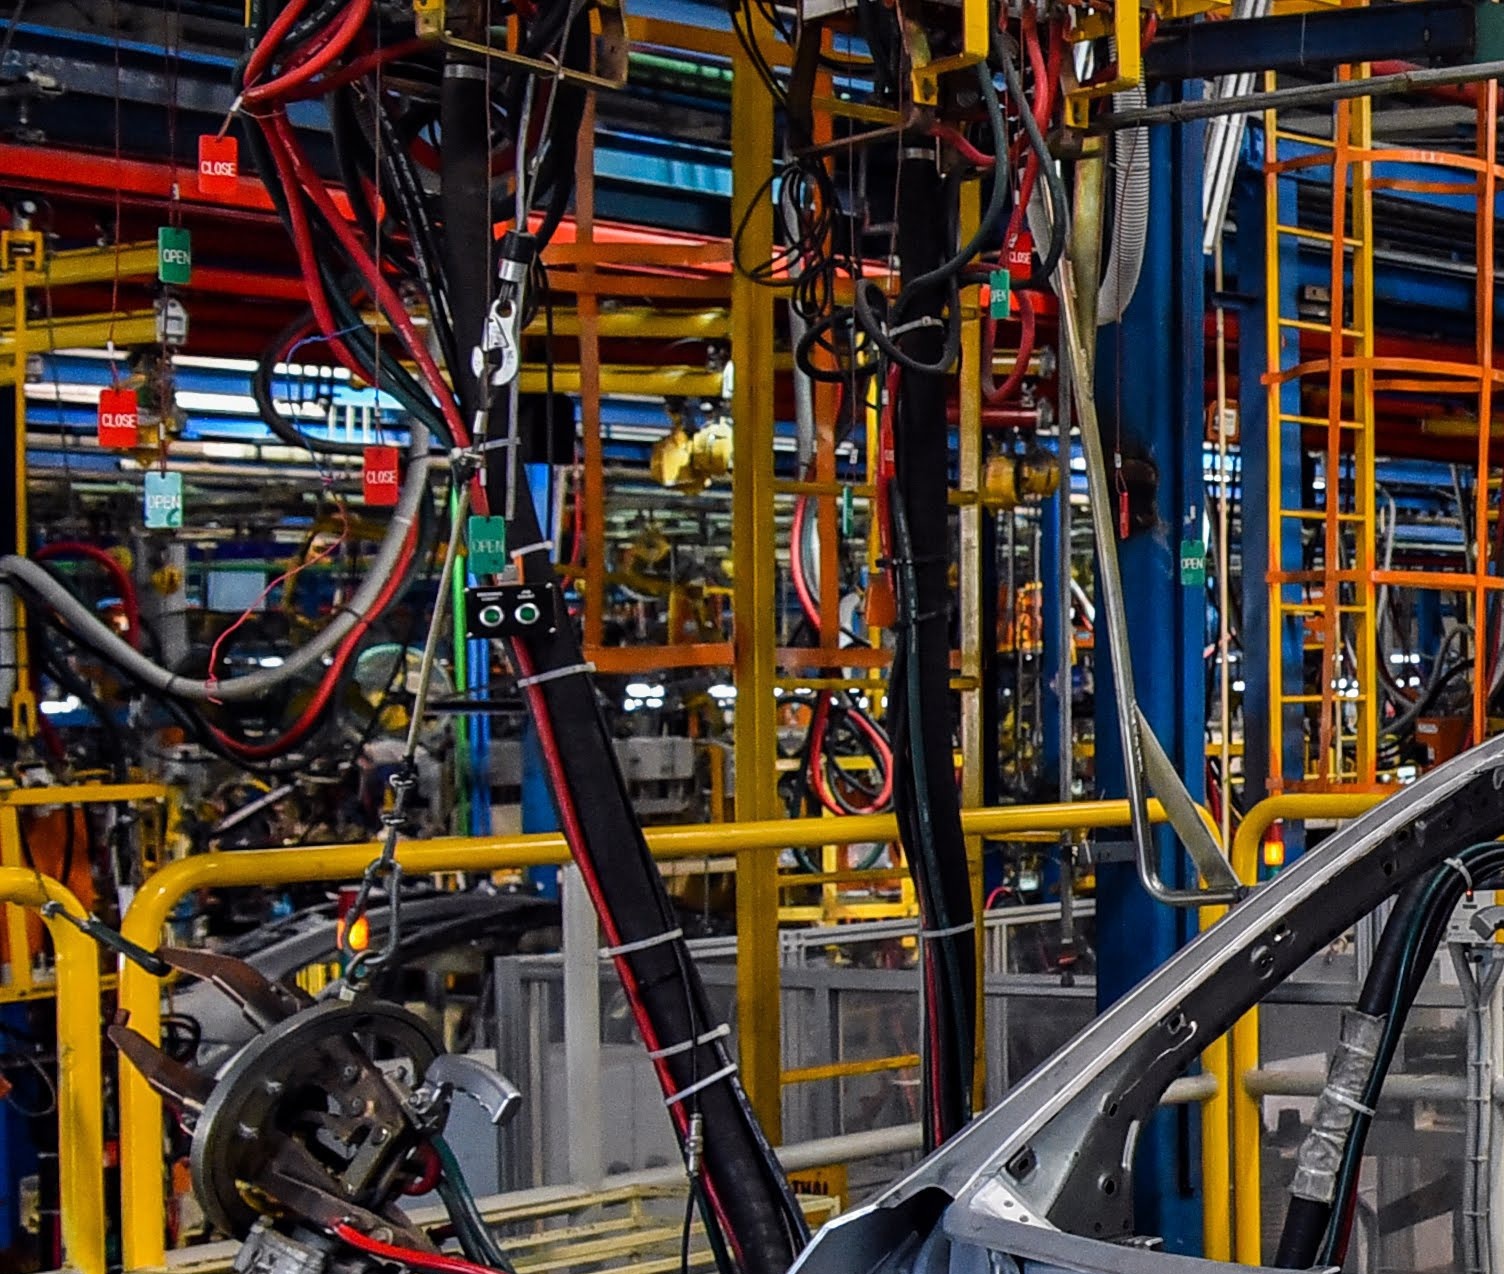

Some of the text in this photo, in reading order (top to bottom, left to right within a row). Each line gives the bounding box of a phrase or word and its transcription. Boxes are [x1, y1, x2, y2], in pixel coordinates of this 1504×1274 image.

[201, 161, 236, 177] CLOSE
[163, 248, 190, 265] OPEN
[1009, 251, 1031, 265] CLOSE
[101, 413, 137, 429] CLOSE
[366, 469, 398, 485] CLOSE
[147, 494, 181, 510] OPEN
[471, 543, 505, 555] OPEN
[1181, 557, 1204, 570] OPEN
